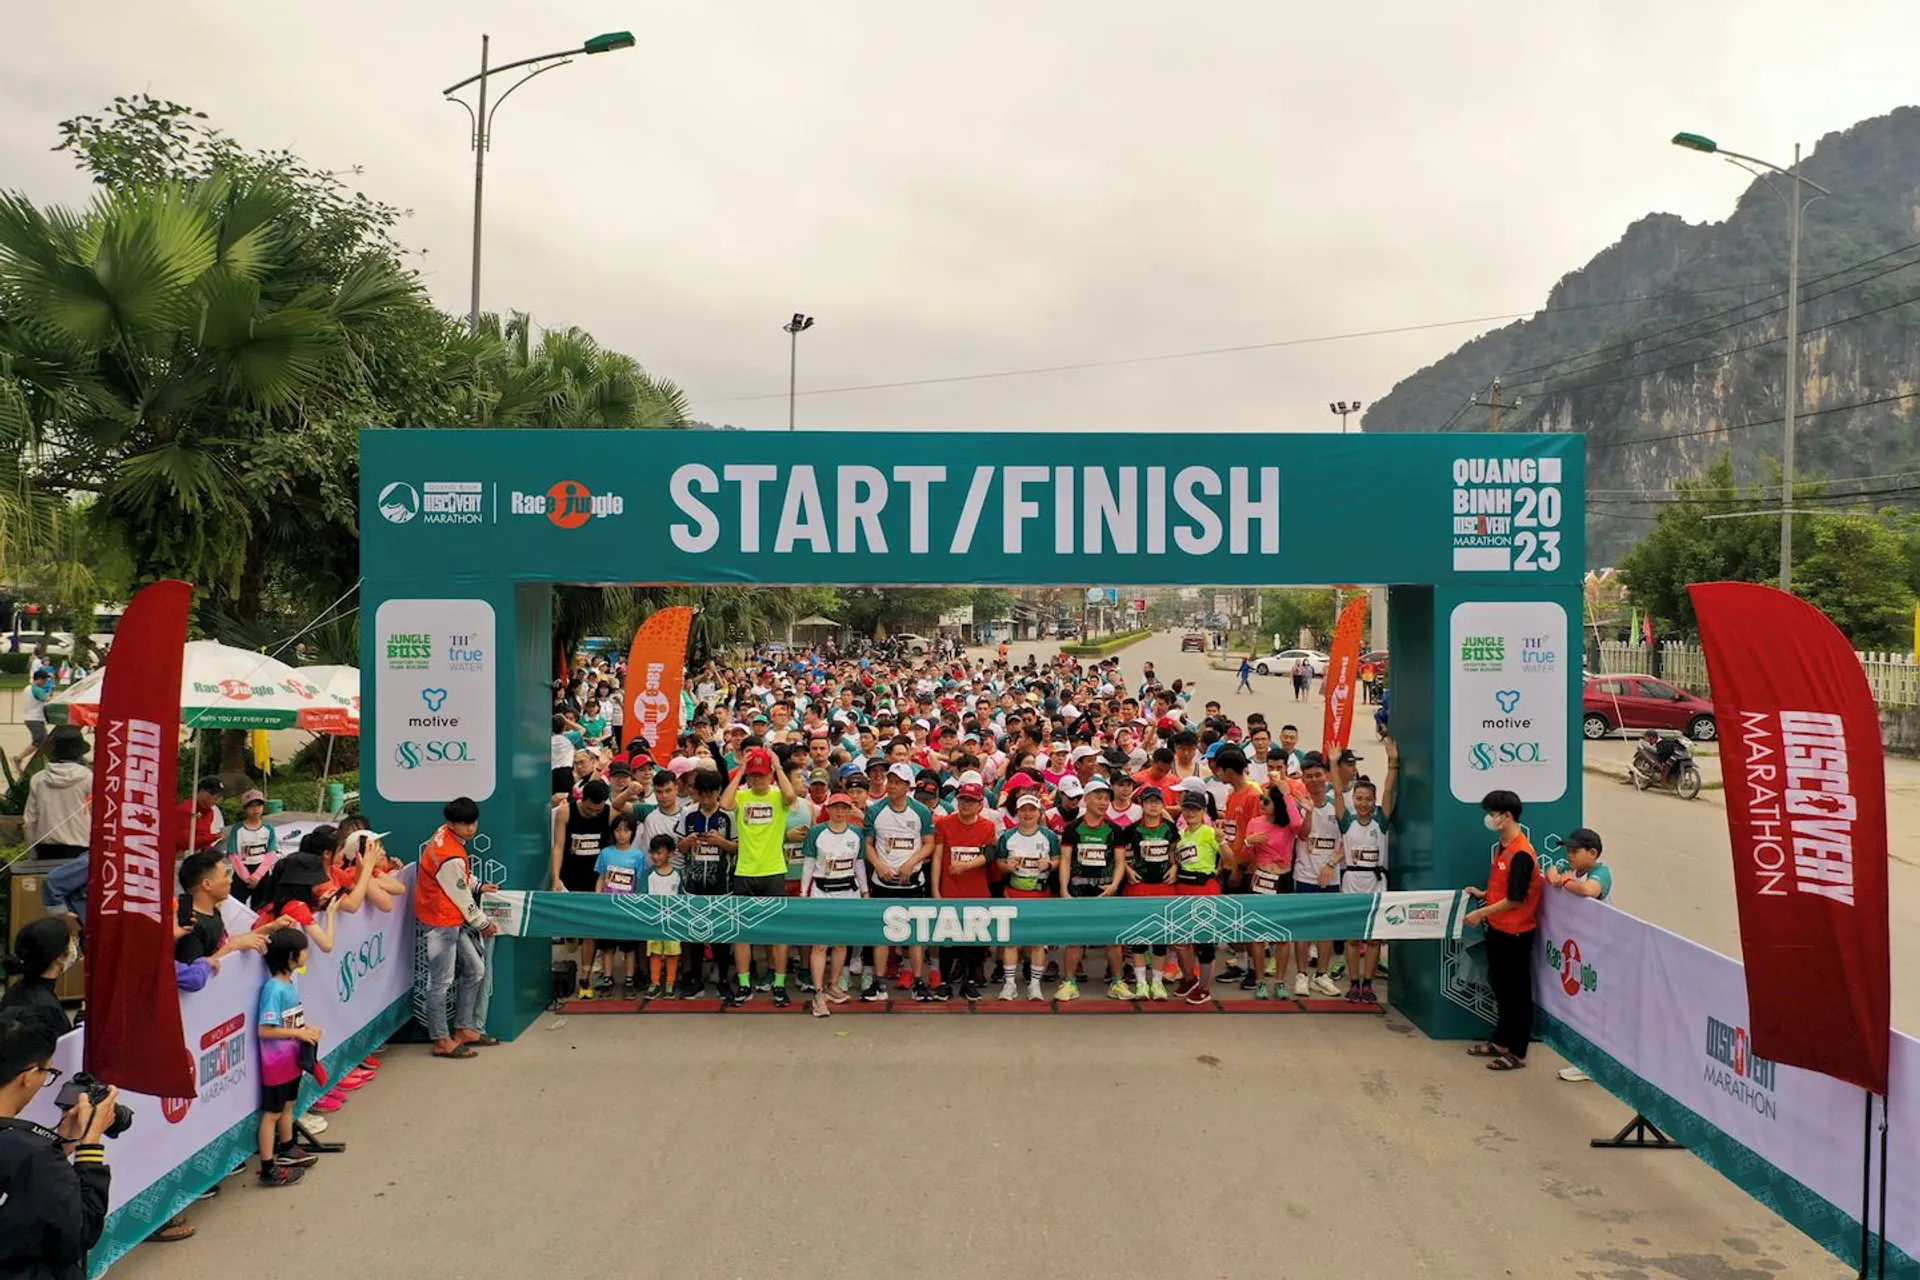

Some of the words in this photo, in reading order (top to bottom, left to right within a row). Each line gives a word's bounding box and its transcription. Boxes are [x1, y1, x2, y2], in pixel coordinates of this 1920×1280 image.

[1453, 458, 1537, 487] QUANG
[424, 493, 482, 513] DISCOVERY
[511, 491, 556, 515] Race
[669, 463, 1280, 555] START/FINISH
[1453, 488, 1512, 514] BINH
[1513, 486, 1562, 528] 20
[424, 513, 482, 524] MARATHON
[1453, 515, 1511, 535] DISCOVERY
[1453, 536, 1512, 546] MARATHON
[1513, 530, 1562, 571] 23
[387, 634, 431, 644] JUNGLE
[449, 635, 468, 646] TH
[1462, 636, 1504, 647] JUNGLE
[1522, 637, 1541, 648] TH
[387, 645, 431, 658] BOSS
[449, 646, 483, 661] true
[1461, 647, 1505, 661] BOSS
[1522, 650, 1555, 663] true
[450, 663, 483, 672] WATER
[1522, 664, 1555, 673] WATER
[218, 715, 232, 723] YOU
[408, 717, 459, 727] motive
[1482, 718, 1531, 729] motive
[426, 741, 476, 762] SOL
[1499, 743, 1547, 763] SOL
[1739, 710, 1788, 896] MARATHON
[1779, 710, 1857, 907] DISCOVERY
[100, 720, 125, 915] MARATHON
[121, 719, 163, 924] DISCOVERY
[883, 906, 1018, 942] START
[200, 1064, 247, 1107] MARATHON
[1703, 1064, 1777, 1121] MARATHON
